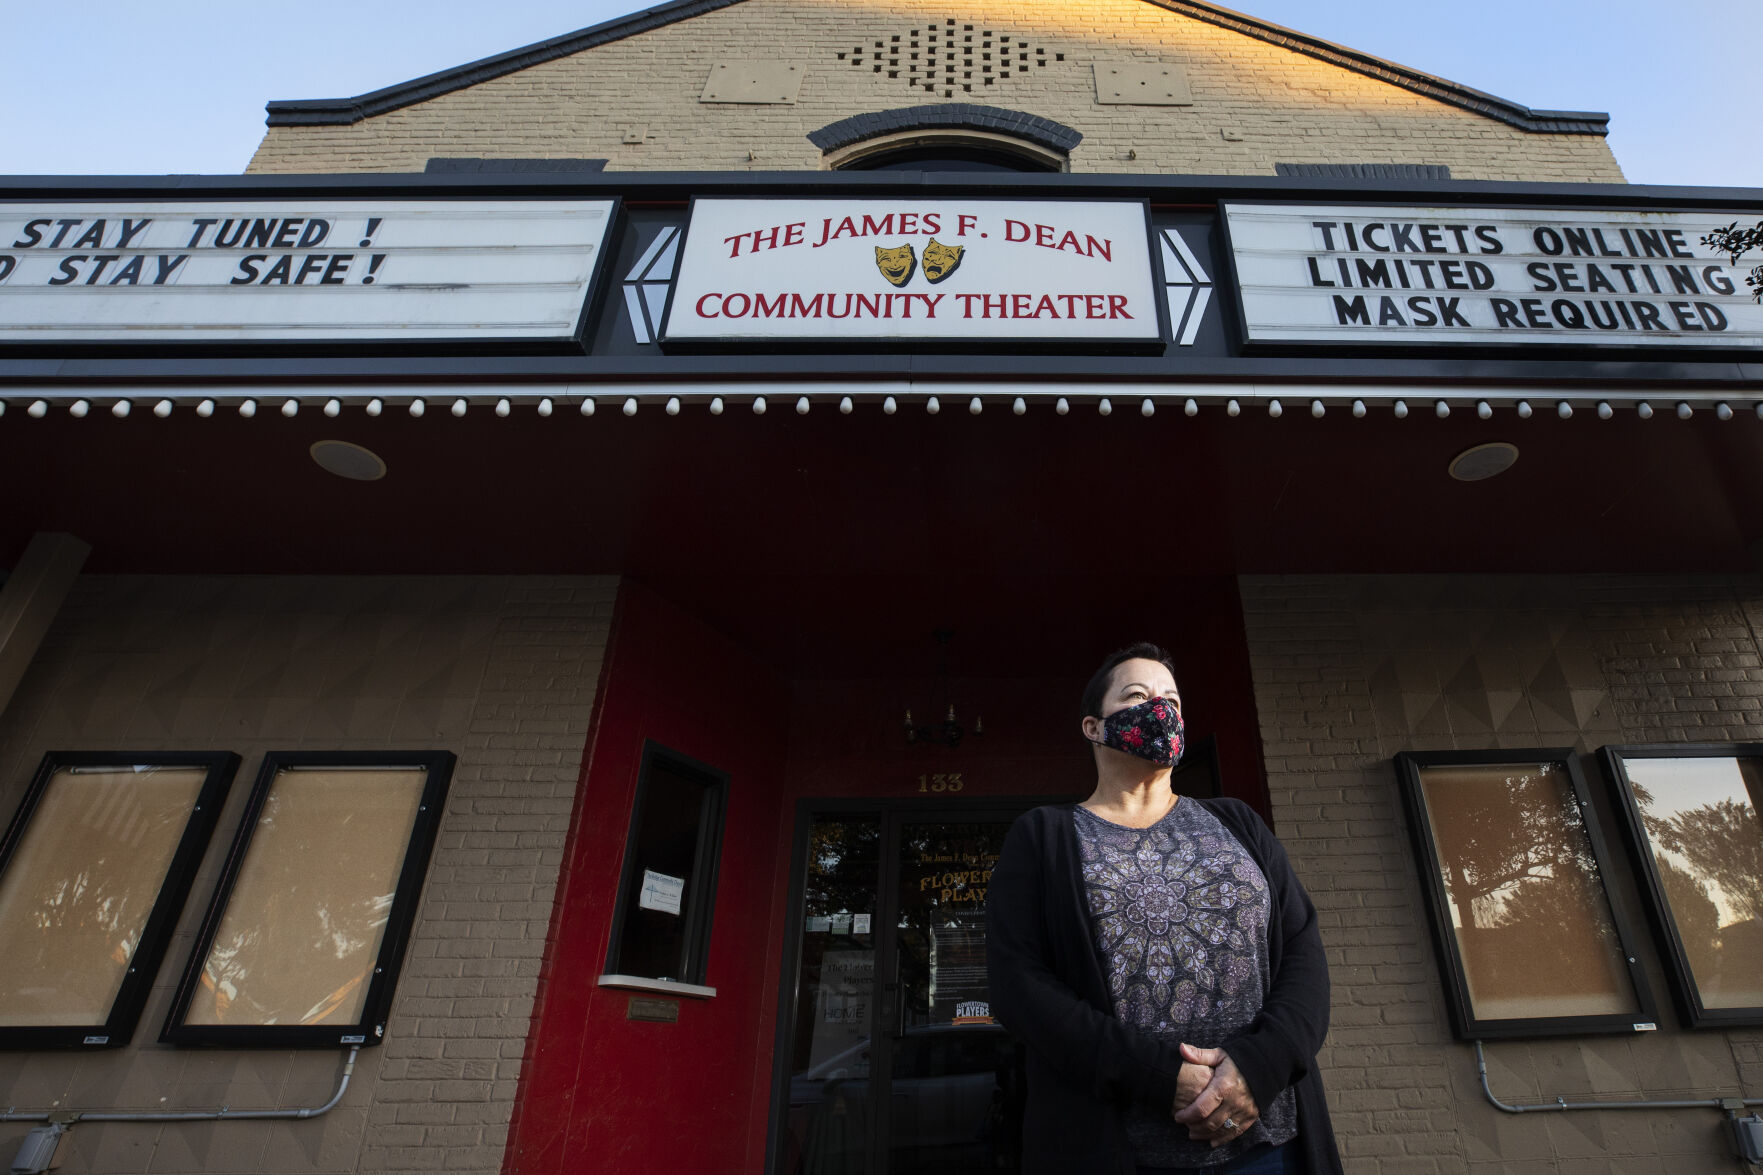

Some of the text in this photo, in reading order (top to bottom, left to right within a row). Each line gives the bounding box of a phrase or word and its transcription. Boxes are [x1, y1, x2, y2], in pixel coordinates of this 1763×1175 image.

[13, 218, 152, 249] STAY
[188, 218, 330, 249] TUNED
[724, 213, 1112, 262] THE JAMES F. DEAN
[1312, 221, 1694, 259] TICKETS ONLINE
[48, 254, 189, 285] STAY
[230, 253, 387, 286] SAFE!
[1307, 256, 1737, 296] LIMITED SEATING
[695, 292, 1134, 320] COMMUNITY THEATER
[1332, 294, 1728, 331] MASK REQUIRED
[918, 773, 964, 792] 133
[941, 887, 987, 902] PLAY
[956, 1007, 990, 1018] PLAYERS
